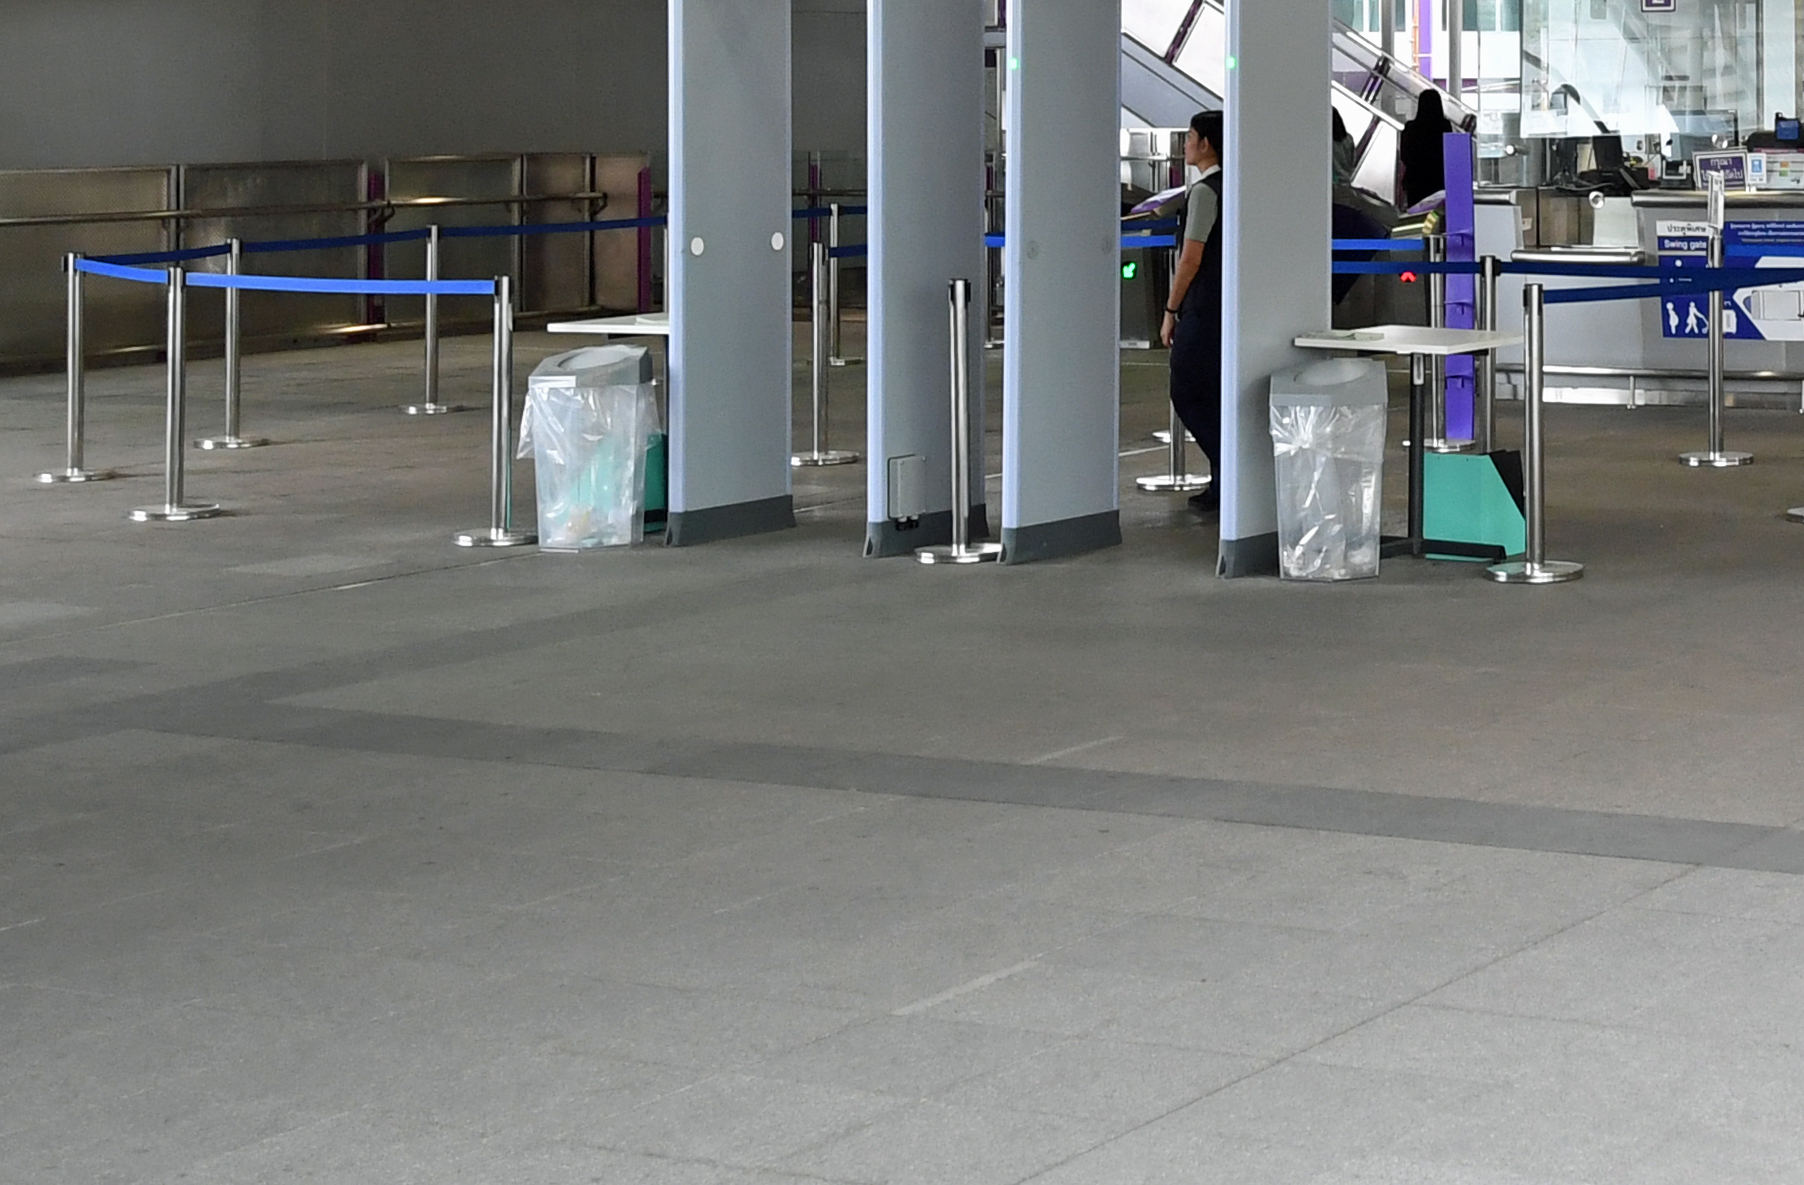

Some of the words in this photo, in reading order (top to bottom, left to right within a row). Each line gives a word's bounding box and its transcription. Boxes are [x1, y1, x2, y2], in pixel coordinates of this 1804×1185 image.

[1710, 158, 1732, 169] กรุณา
[1667, 223, 1707, 236] ประตูพิเศษ
[1664, 238, 1688, 250] Swing
[1689, 240, 1707, 250] gate
